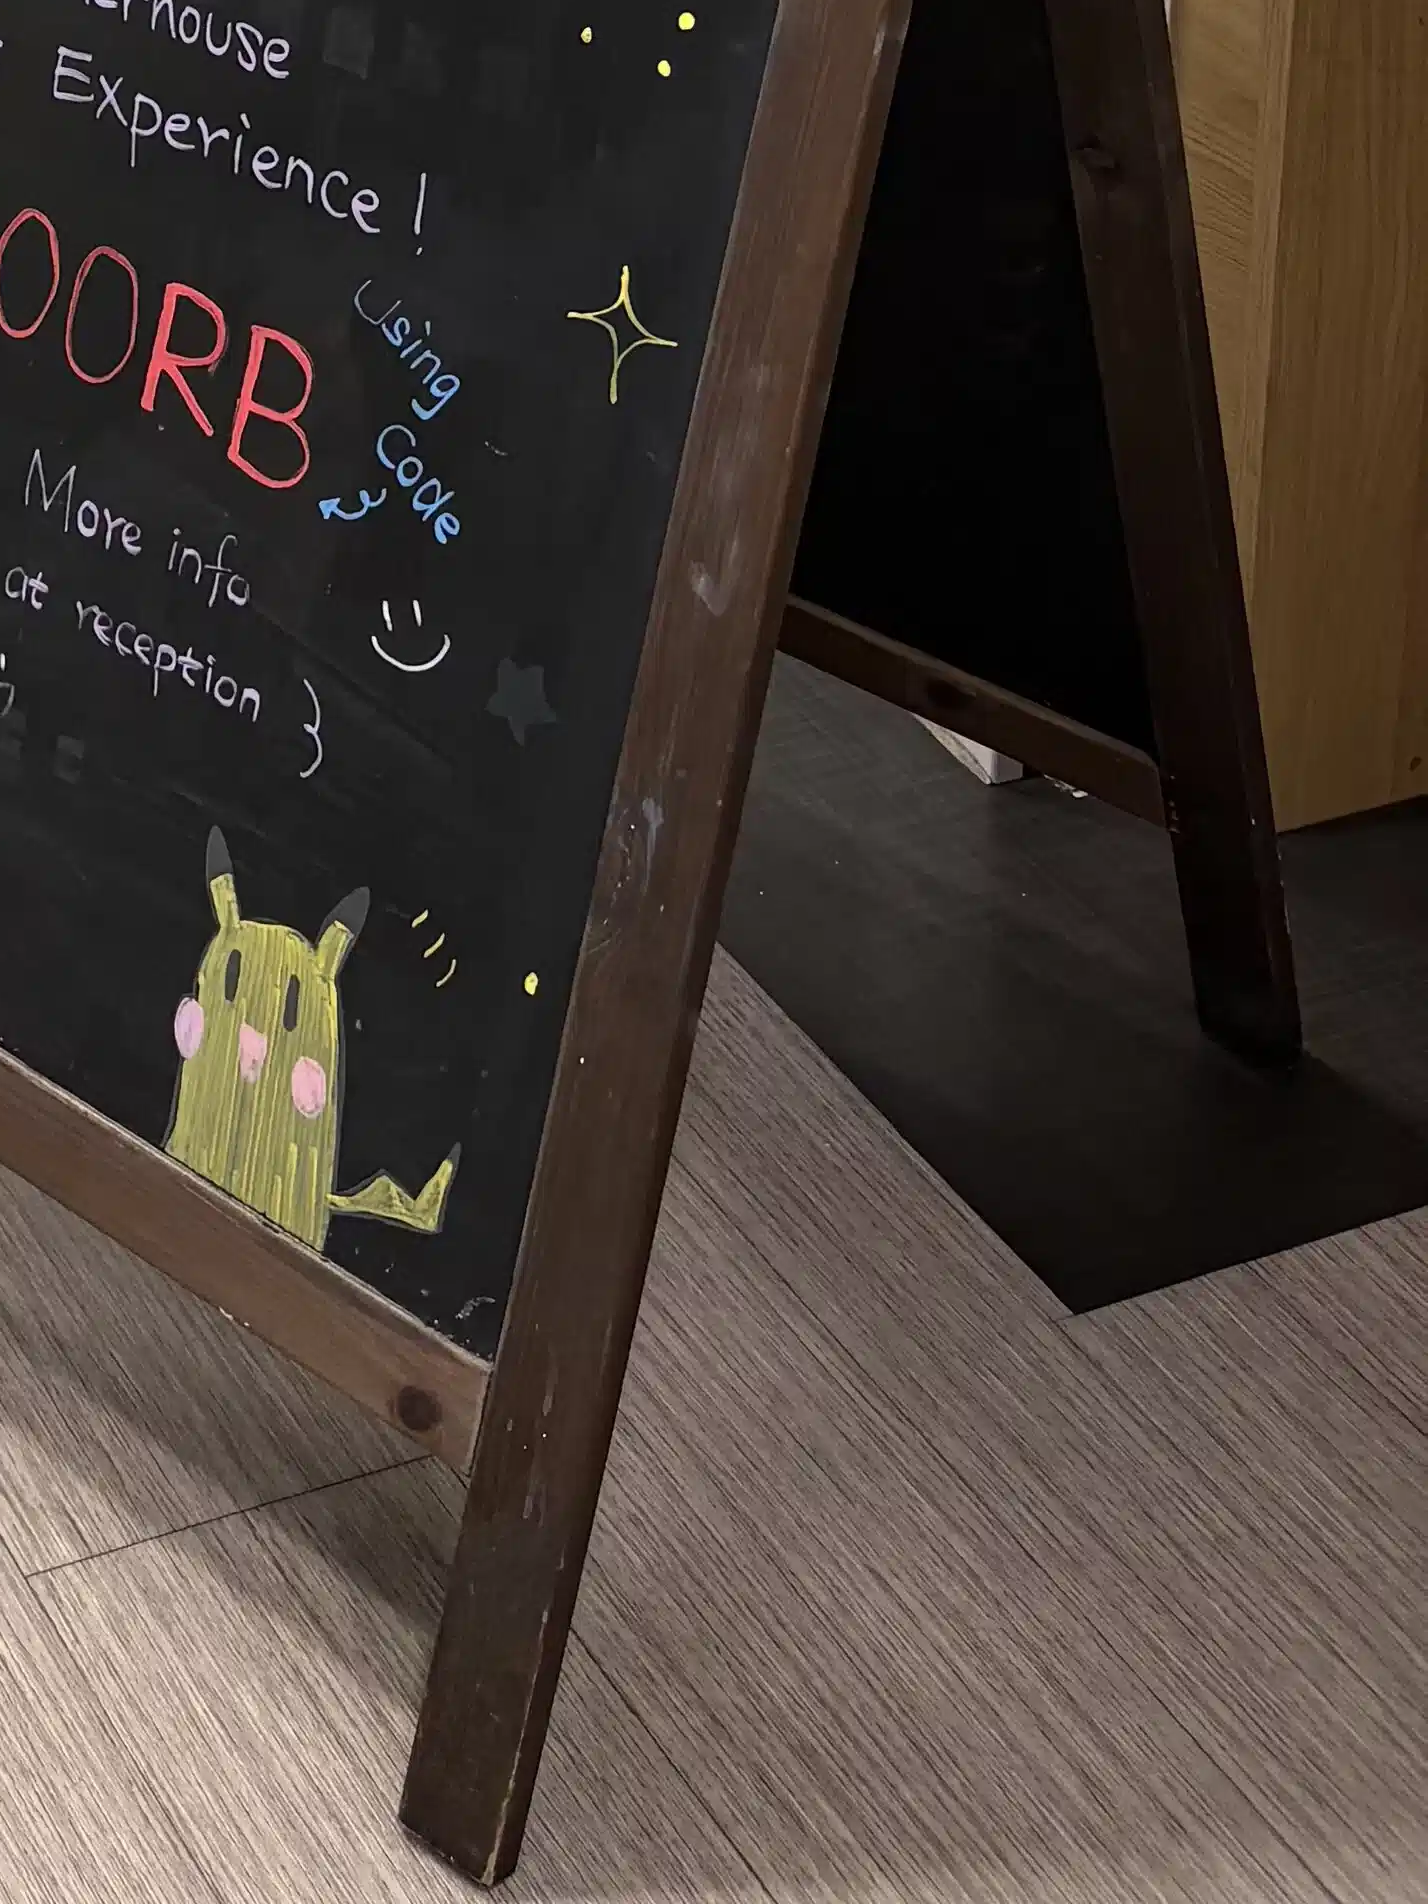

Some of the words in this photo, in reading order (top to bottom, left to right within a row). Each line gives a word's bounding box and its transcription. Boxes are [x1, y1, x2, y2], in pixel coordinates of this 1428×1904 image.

[353, 279, 462, 421] Using
[24, 448, 143, 556] More
[167, 527, 250, 608] info
[376, 424, 462, 545] Code
[4, 566, 49, 611] at
[76, 600, 262, 724] reception
